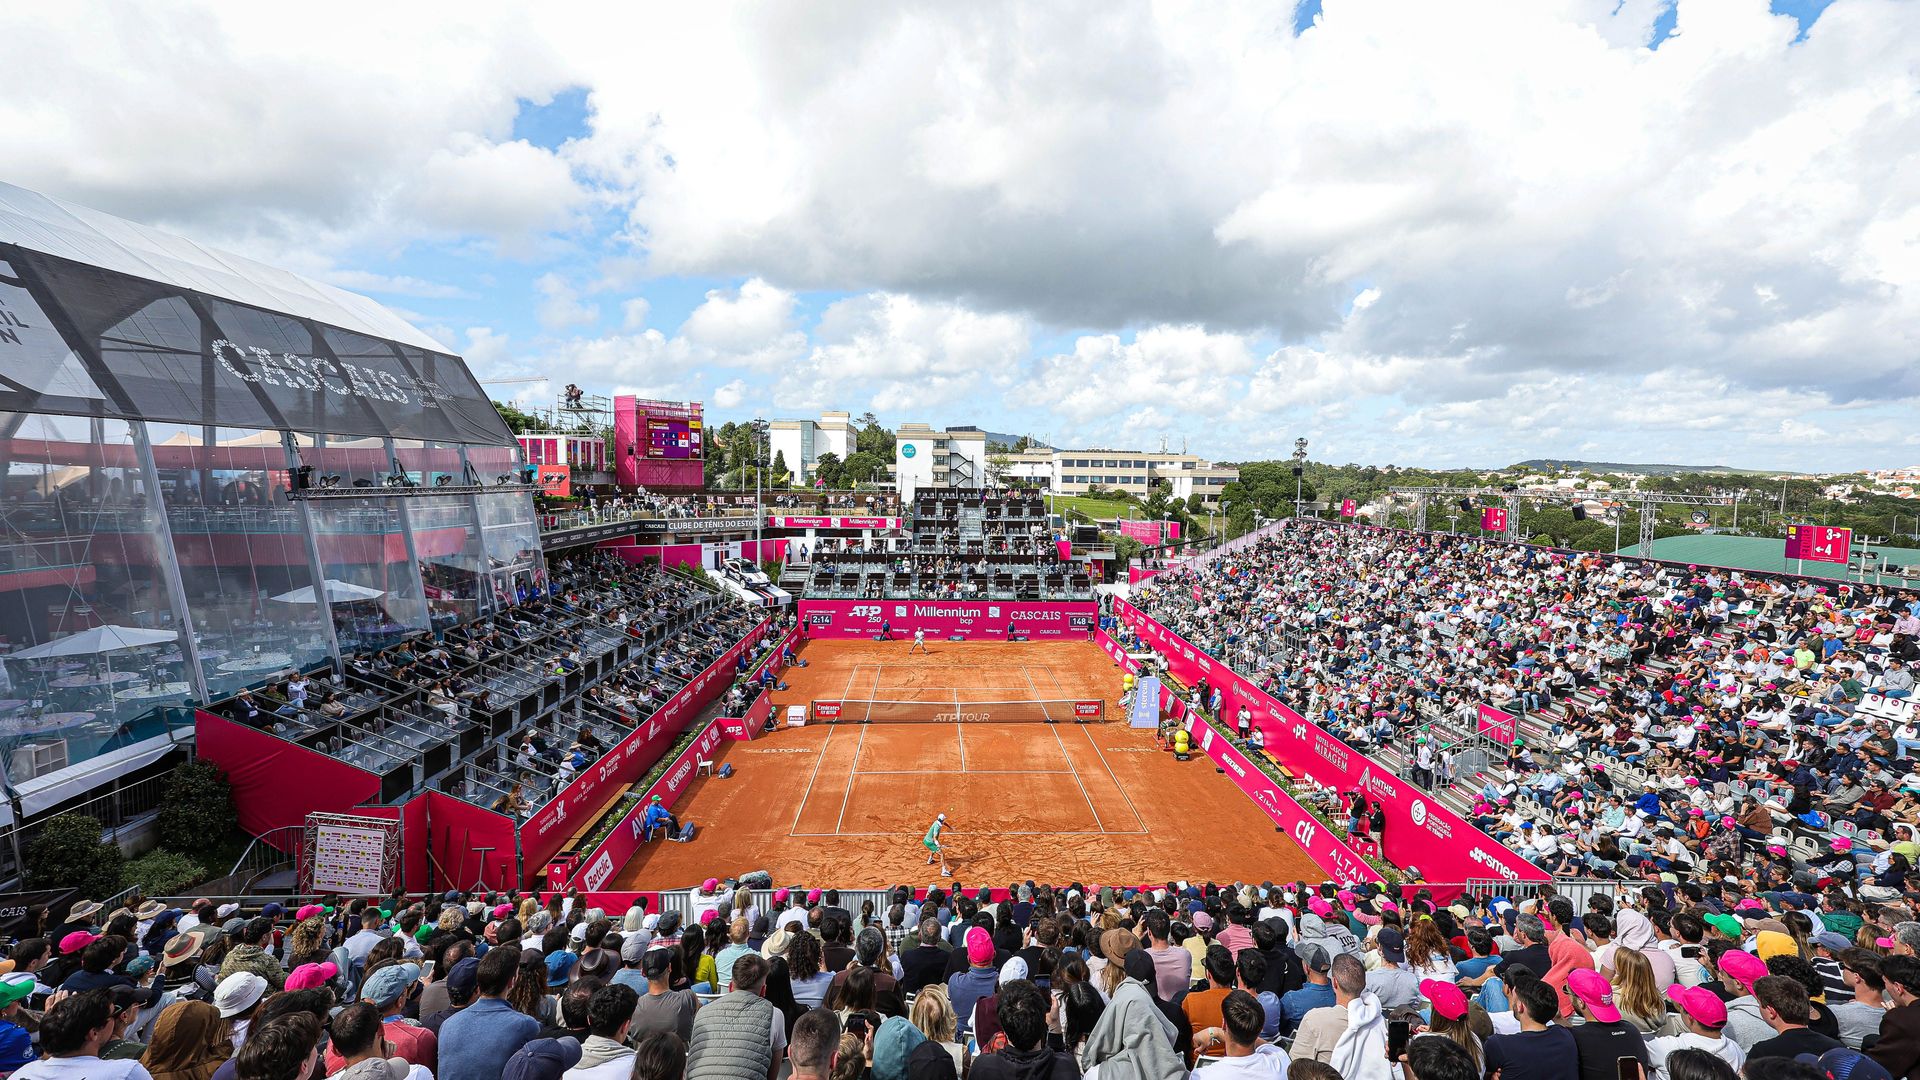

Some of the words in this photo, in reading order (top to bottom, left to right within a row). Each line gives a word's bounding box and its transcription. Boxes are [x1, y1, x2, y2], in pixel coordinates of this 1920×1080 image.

[211, 338, 408, 405] CASCAIS
[417, 398, 440, 409] Coast
[668, 522, 692, 530] CLUBE
[693, 521, 703, 529] DE
[704, 519, 724, 529] TÉNIS
[737, 519, 760, 527] ESTOR
[1826, 528, 1833, 541] 3
[1824, 543, 1832, 556] 4
[848, 605, 882, 617] ATP
[914, 604, 981, 617] Millennium
[1010, 611, 1061, 620] CASCAIS
[812, 615, 830, 624] 2:14
[959, 617, 974, 625] bcp
[1072, 617, 1086, 625] 148
[933, 713, 957, 722] ATP
[960, 713, 991, 722] TOUR
[1481, 711, 1514, 734] Millennium
[725, 725, 743, 733] ATP
[1315, 733, 1330, 748] HOTEL
[1329, 743, 1349, 760] CASCAIS
[605, 753, 621, 769] HOSPITAL
[1314, 741, 1348, 772] MIRAGEM
[1221, 752, 1247, 778] SKECHERS
[666, 760, 692, 792] NESPRESSO
[1371, 775, 1397, 799] ANTHEA
[1253, 790, 1283, 817] AZIMUT
[1428, 812, 1452, 831] FEDERAÇÃO
[1295, 820, 1315, 848] ctt
[1427, 818, 1452, 839] PORTUGUESA
[553, 866, 561, 874] 4
[588, 857, 610, 891] Betclic
[1485, 854, 1519, 882] smeg
[0, 906, 27, 918] CAIS
